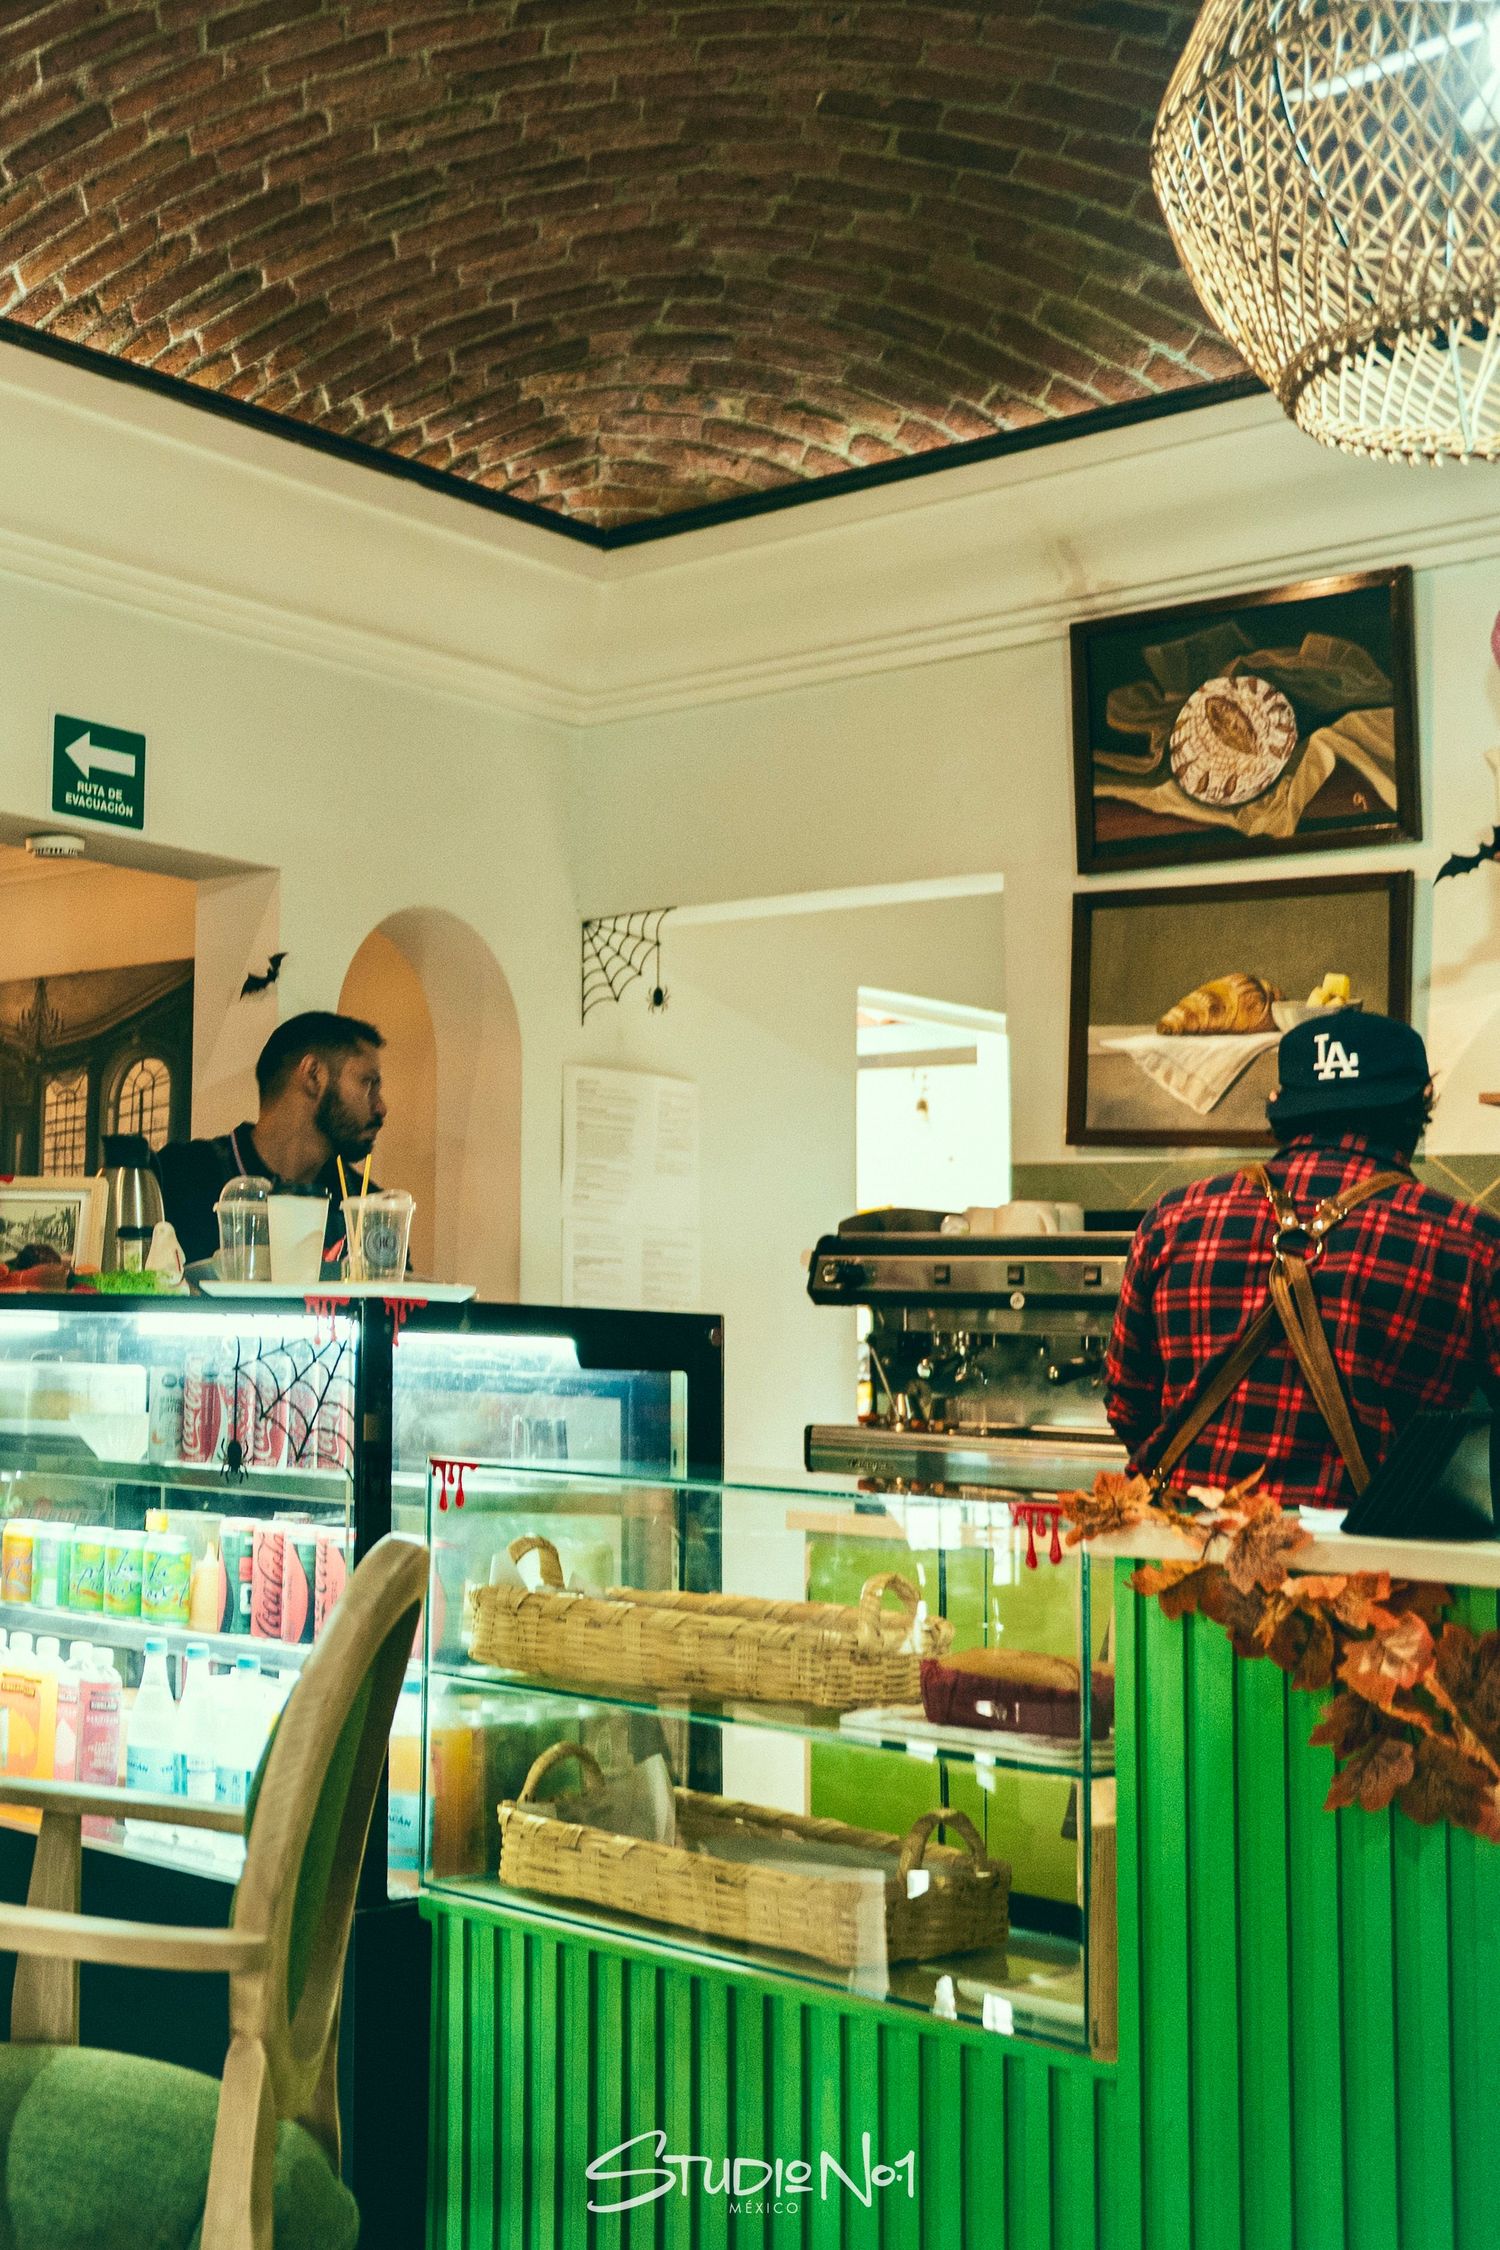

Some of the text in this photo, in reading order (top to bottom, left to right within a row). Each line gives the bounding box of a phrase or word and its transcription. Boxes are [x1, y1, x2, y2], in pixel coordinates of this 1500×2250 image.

[77, 780, 123, 801] RUTA DE
[65, 791, 133, 818] EVACUACIÓN
[1313, 1032, 1359, 1081] LA
